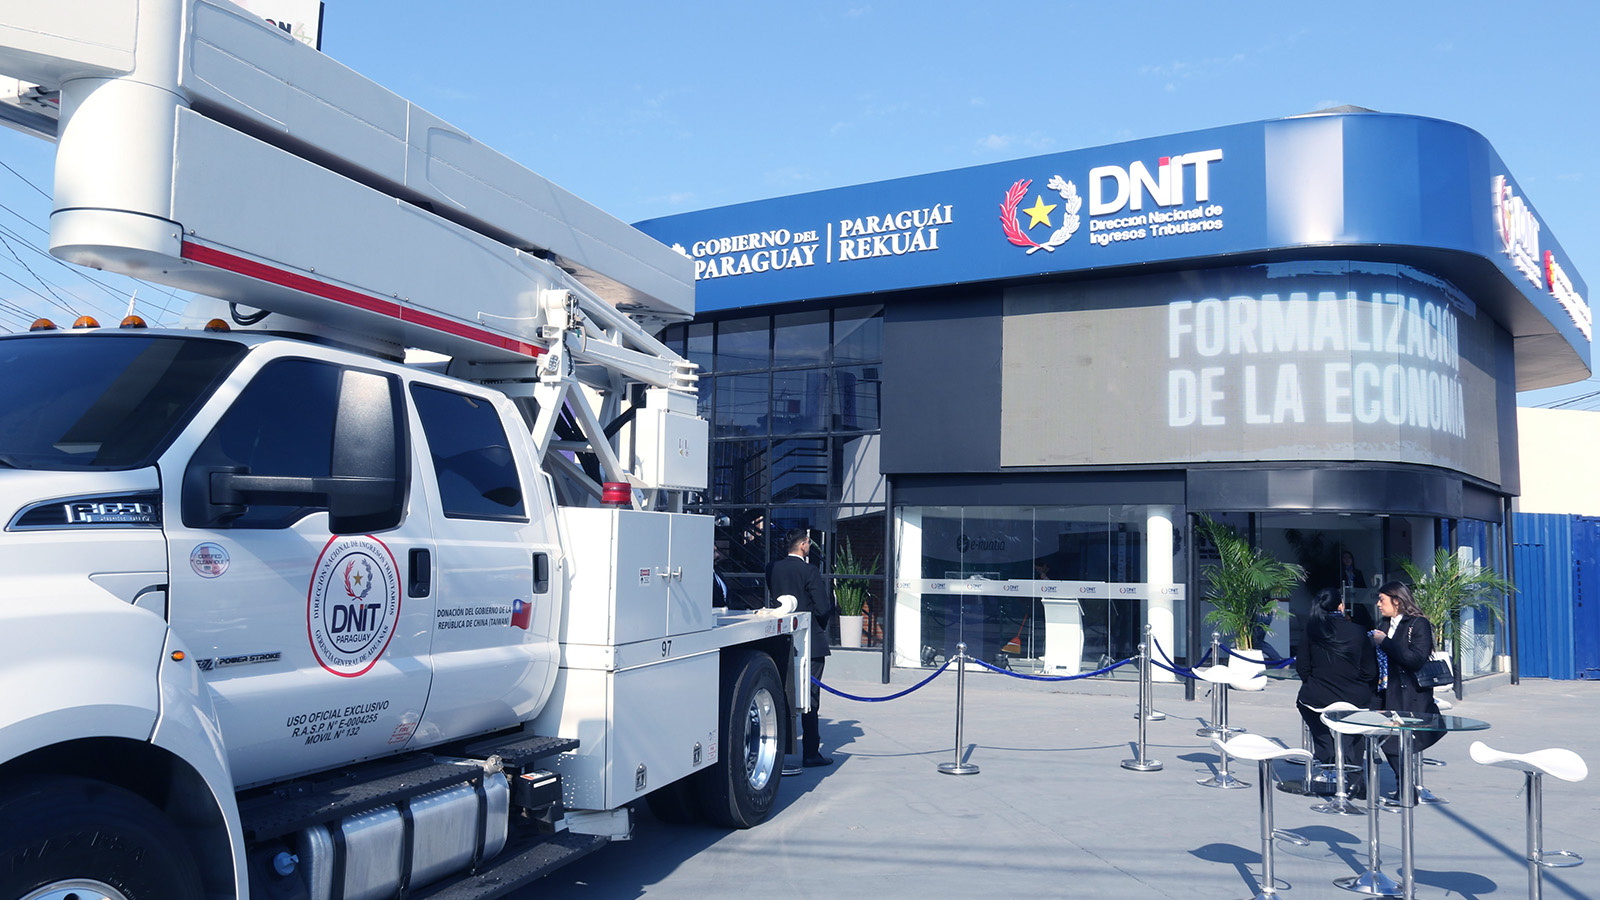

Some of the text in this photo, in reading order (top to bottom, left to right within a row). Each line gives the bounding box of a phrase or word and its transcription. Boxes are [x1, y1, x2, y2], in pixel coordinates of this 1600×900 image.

[1089, 148, 1223, 216] DNIT
[839, 203, 953, 238] PARAGUÁI
[1149, 206, 1203, 224] Nacional
[1205, 204, 1223, 217] de
[692, 228, 819, 259] GOBIERNO DEL
[838, 227, 939, 262] REKUÁI
[1090, 219, 1223, 247] Ingresos Tributarios
[694, 244, 819, 281] PARAGUAY
[1168, 291, 1460, 371] FORMALIZACIÓN
[1168, 362, 1466, 440] DE LA ECONOMÍA
[314, 569, 327, 620] DIRECCIÓN
[325, 541, 350, 570] NACIONAL
[359, 541, 385, 563] INGRESOS
[384, 561, 396, 616] TRIBUTARIOS
[331, 603, 381, 633] DNIT
[437, 606, 512, 617] DONACIÓN DEL GOBIERNO DE LA
[437, 617, 510, 630] REPÚBLICA DE CHINA (TAIWAN)
[315, 625, 389, 667] GERENCIA GENERAL DE ADUANAS
[336, 633, 371, 644] PARAGUAY
[661, 640, 672, 657] 97
[220, 656, 249, 665] POWER
[249, 652, 281, 662] STROKE
[286, 700, 390, 727] USO OFICIAL EXCLUSIVO
[338, 713, 379, 729] E-0004255
[304, 731, 332, 746] MOVIL
[345, 726, 361, 737] 132
